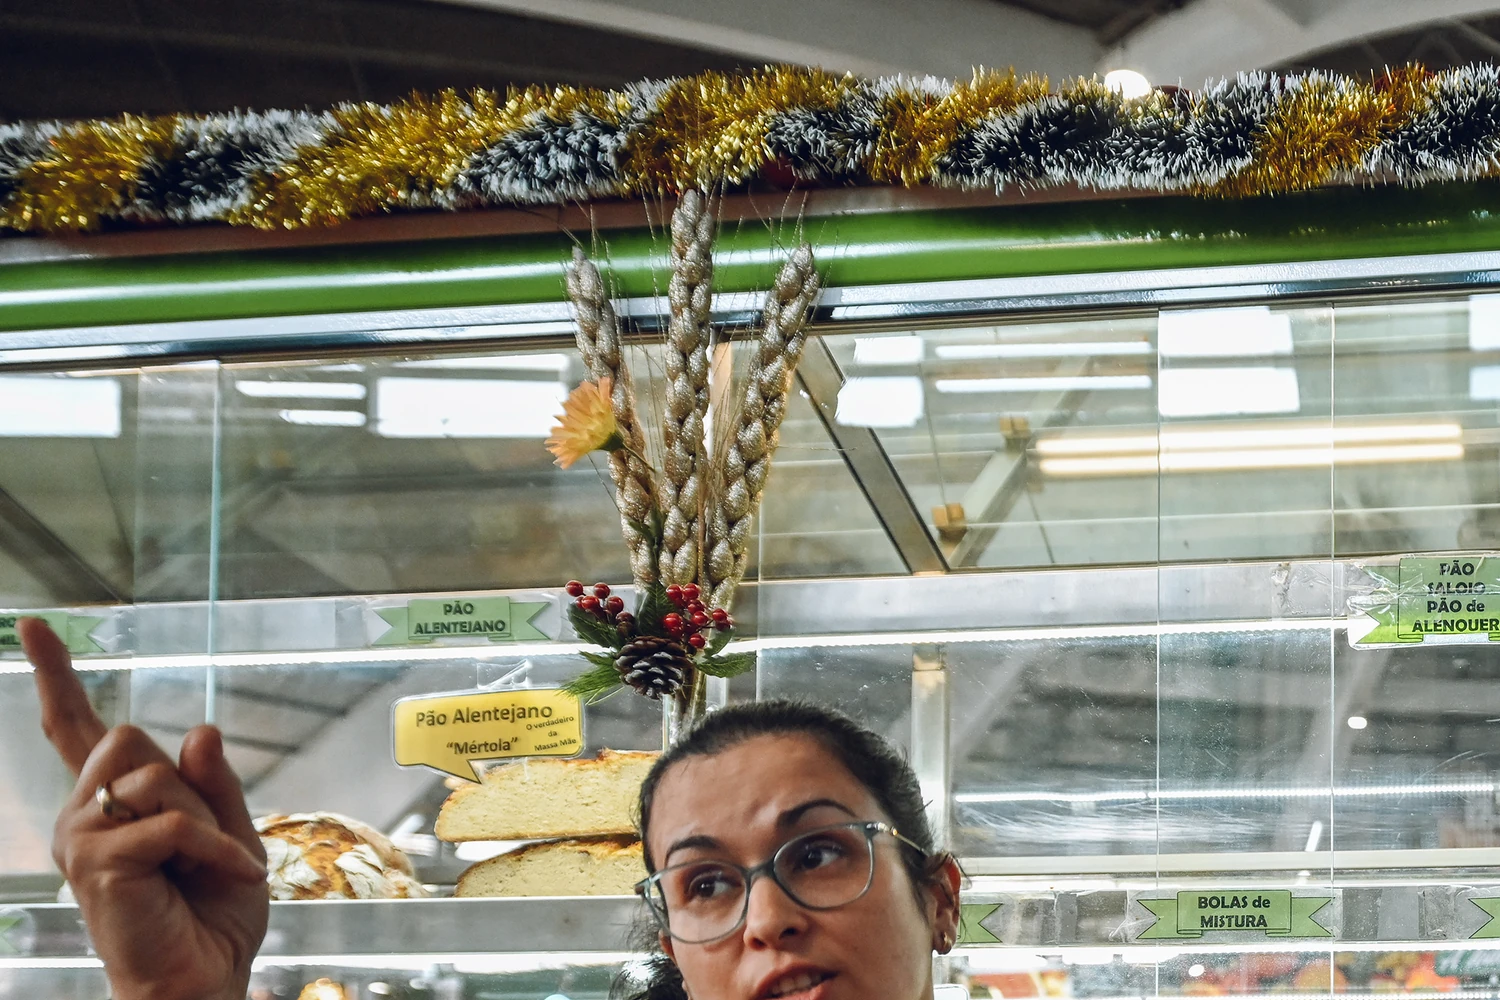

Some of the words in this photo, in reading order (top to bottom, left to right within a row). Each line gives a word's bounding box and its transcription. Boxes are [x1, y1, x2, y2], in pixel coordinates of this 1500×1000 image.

[1439, 560, 1474, 576] PÃO
[443, 601, 474, 615] PÃO
[1427, 597, 1462, 613] PÃO
[1466, 599, 1485, 612] de
[414, 619, 506, 634] ALENTEJANO
[416, 709, 447, 727] Pão
[452, 704, 553, 724] Alentejano
[534, 715, 574, 730] verdadeiro
[534, 742, 558, 751] Massa
[559, 738, 576, 747] Mãe
[1198, 896, 1248, 909] BOLAS
[1252, 896, 1271, 908] de
[1200, 915, 1268, 928] MISTURA
